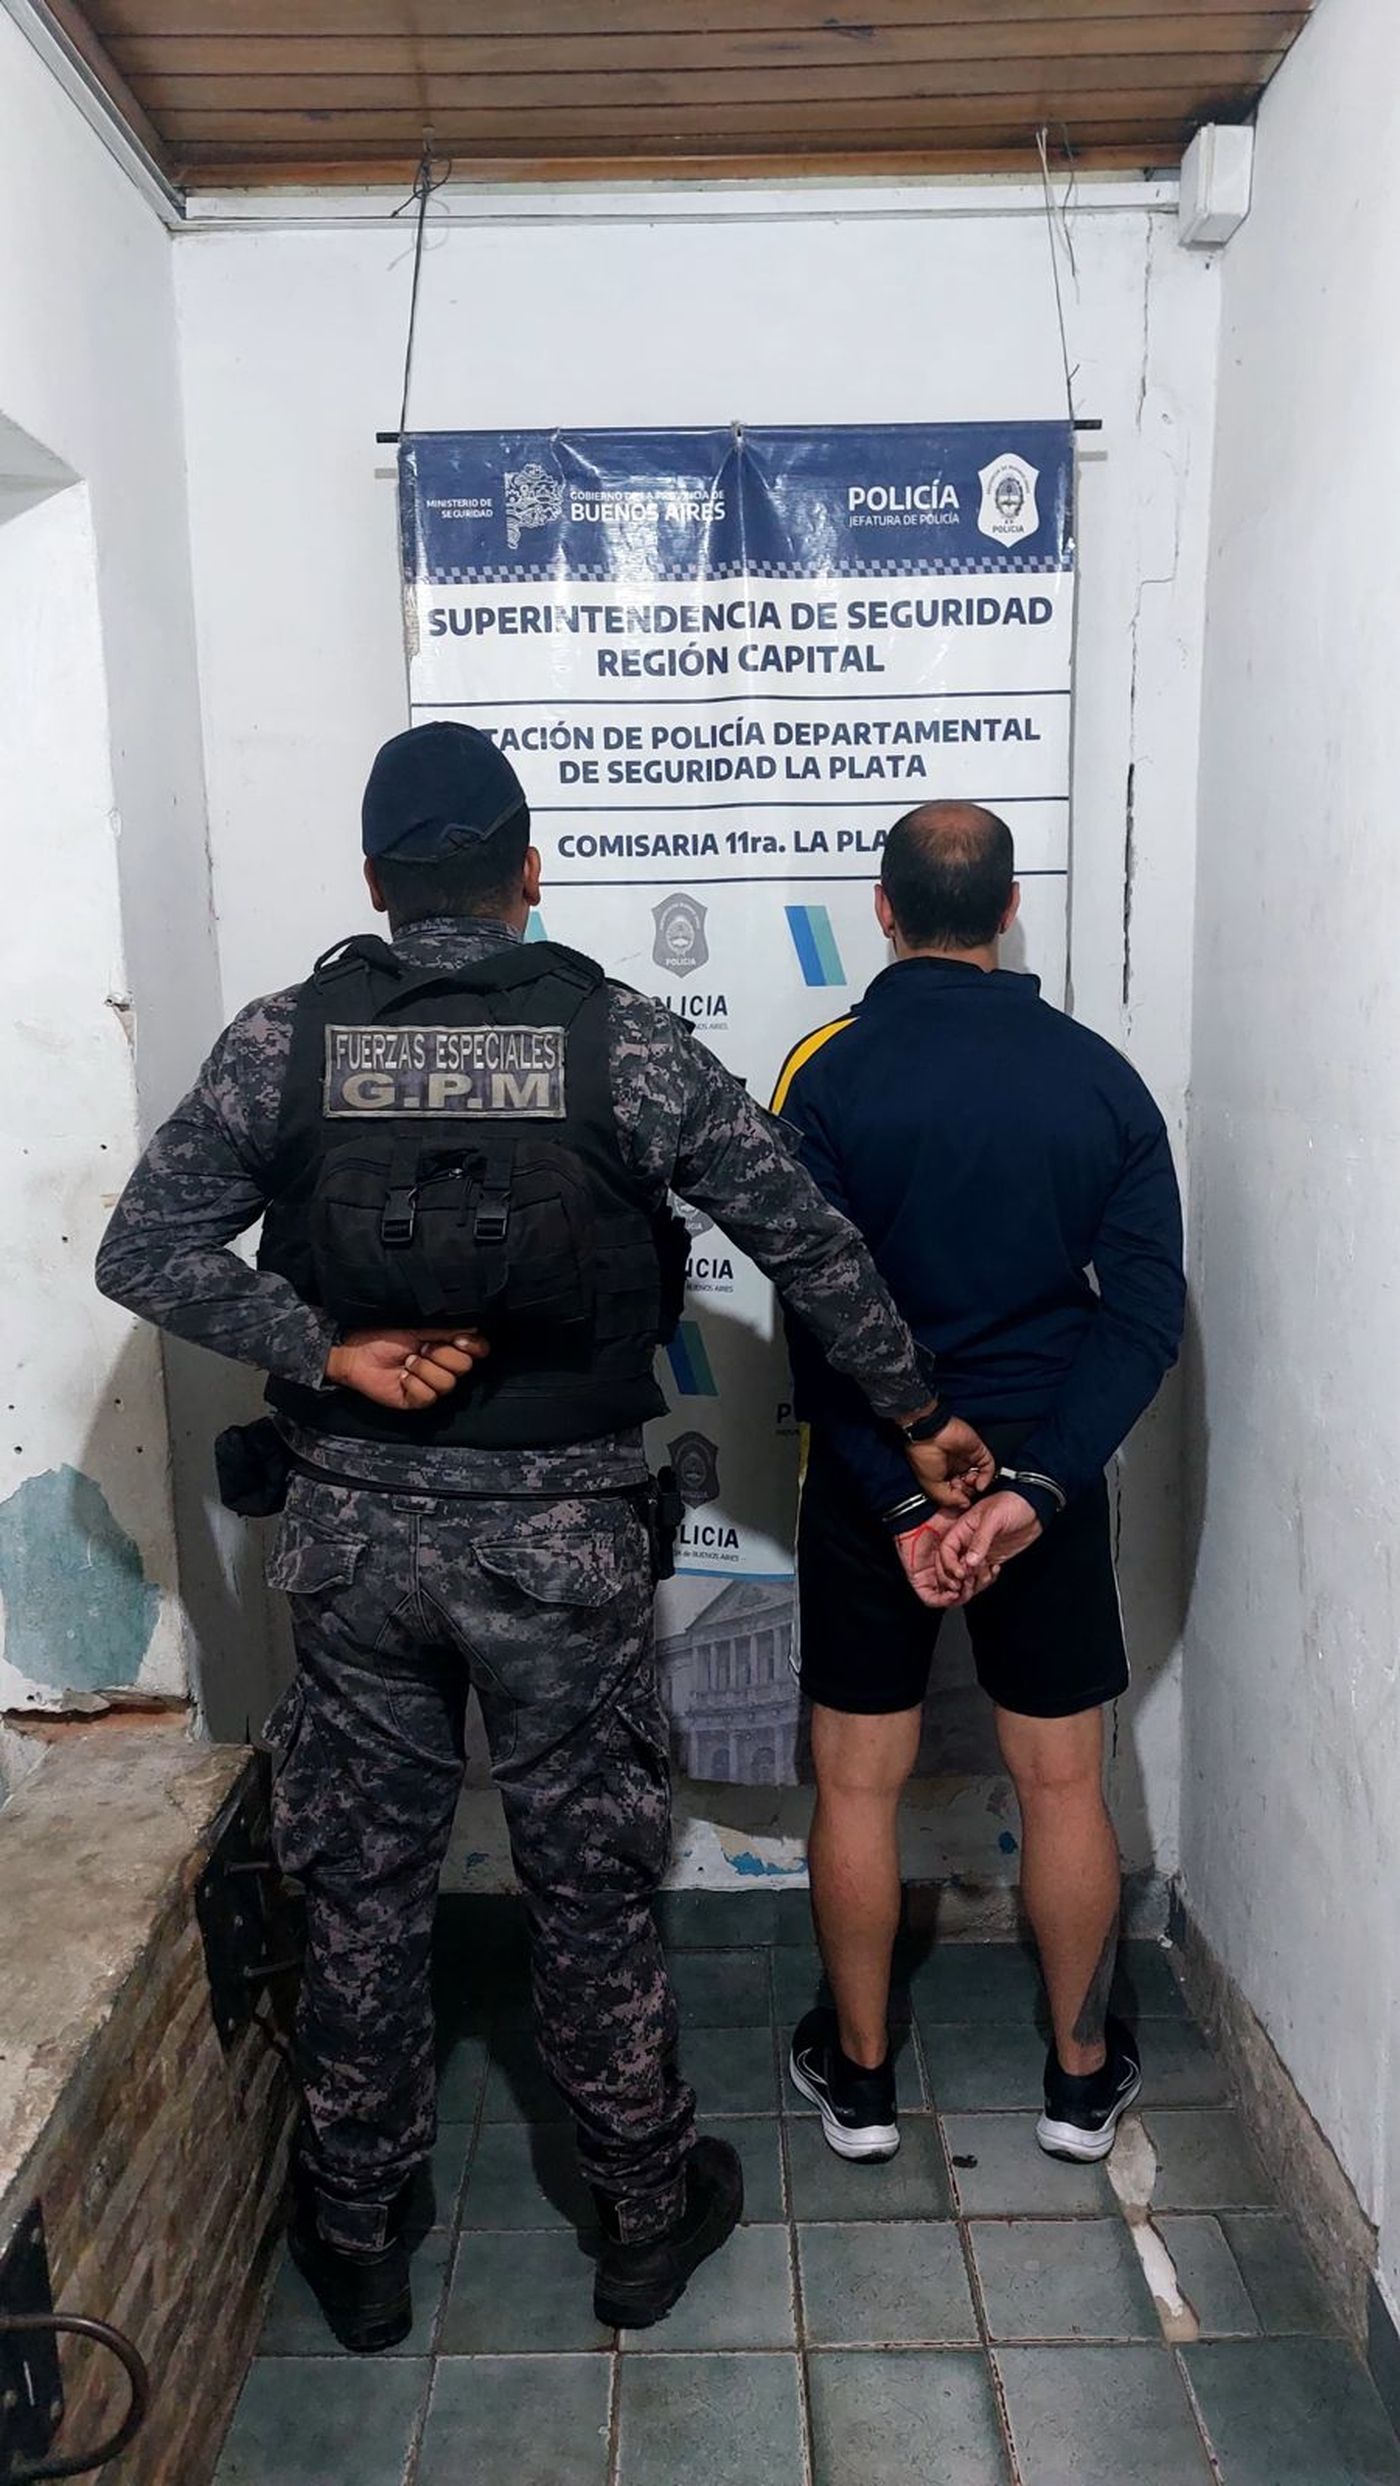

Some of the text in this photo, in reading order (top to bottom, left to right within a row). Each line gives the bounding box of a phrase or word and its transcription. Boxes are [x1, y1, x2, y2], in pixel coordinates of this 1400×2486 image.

[426, 498, 493, 508] MINISTERIO DE
[569, 490, 625, 502] GOBIERNO
[848, 479, 960, 511] POLICÍA
[441, 509, 494, 519] SEGURIDAD
[570, 502, 727, 522] BUENOS AIRES
[849, 511, 960, 528] JEFATURA DE POLICÍA
[992, 524, 1025, 534] POLICIA
[428, 597, 1053, 637] SUPERINTENDENCIA DE SEGURIDAD
[597, 641, 885, 677] REGIÓN CAPITAL
[603, 726, 643, 750] DE
[652, 716, 766, 750] POLICÍA
[773, 718, 1041, 746] DEPARTAMENTAL
[559, 754, 927, 784] DE SEGURIDAD LA PLATA
[558, 829, 888, 857] COMISARIA 11ra. LA PLA
[336, 1033, 557, 1070] FUERZAS ESPECIALES
[342, 1072, 551, 1109] G.P.M
[680, 1524, 739, 1549] LICIA
